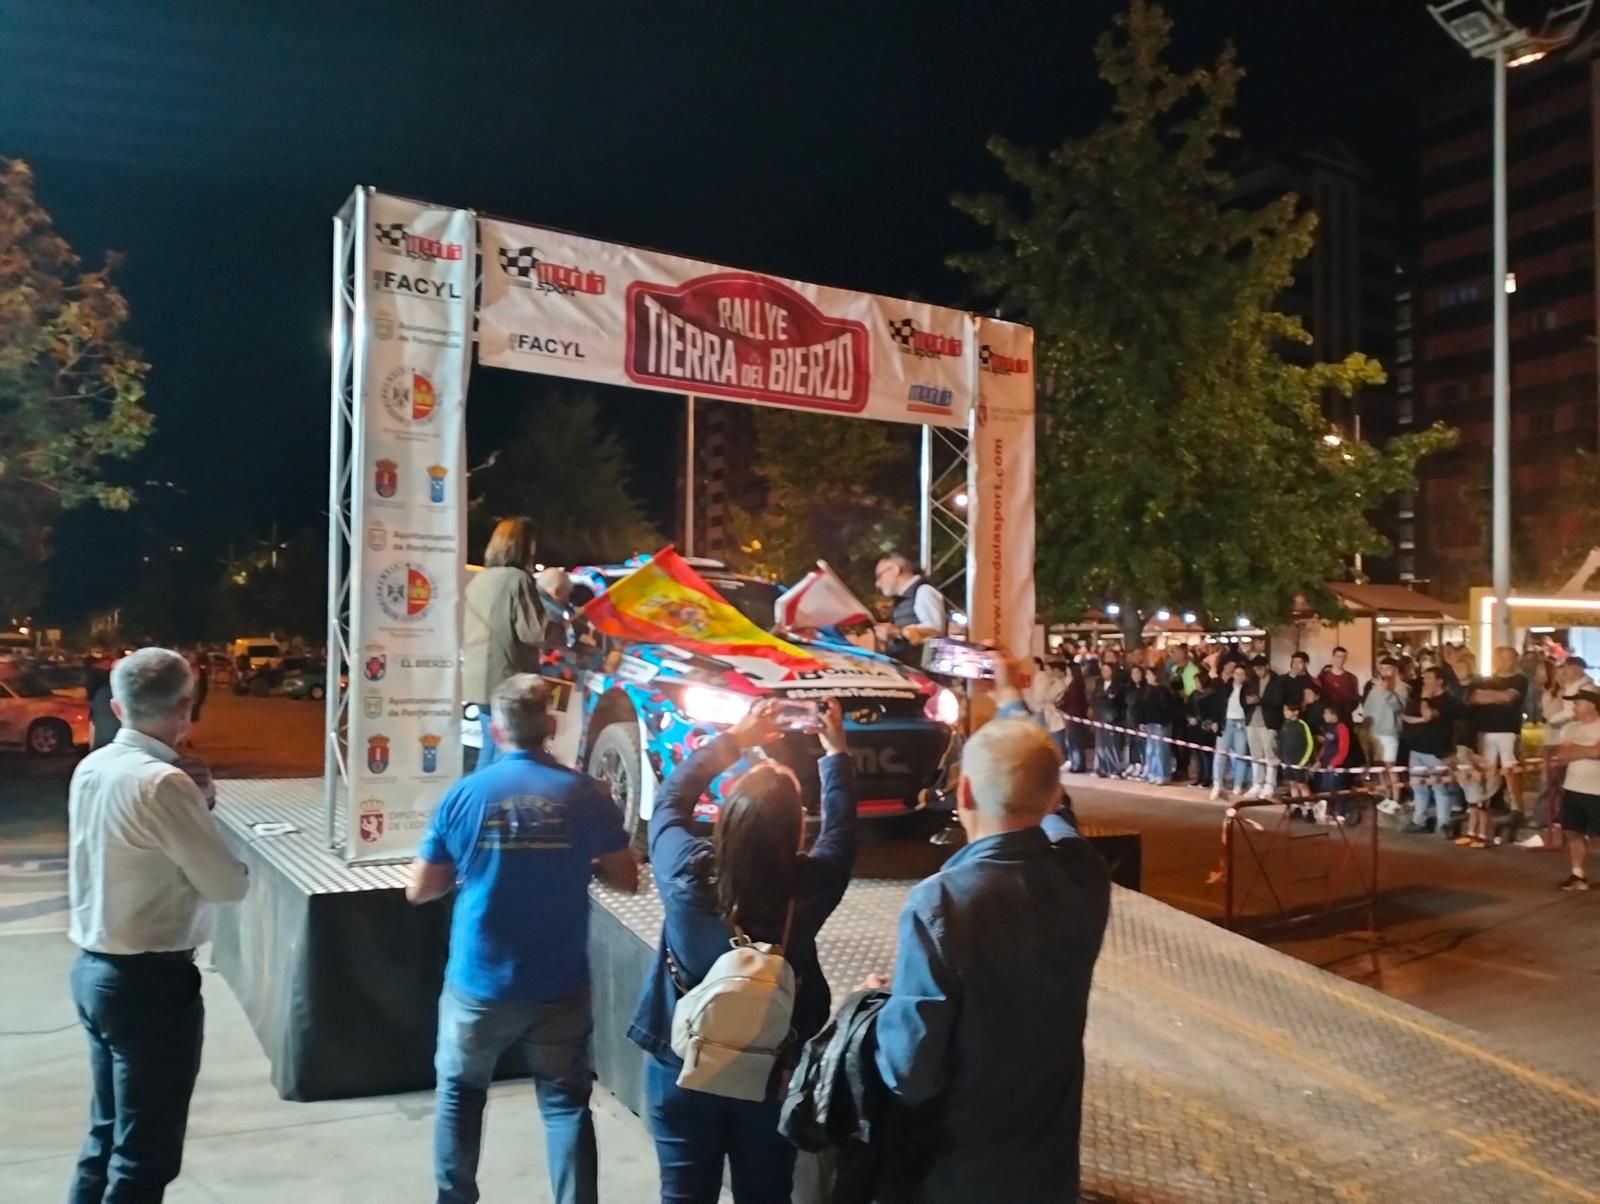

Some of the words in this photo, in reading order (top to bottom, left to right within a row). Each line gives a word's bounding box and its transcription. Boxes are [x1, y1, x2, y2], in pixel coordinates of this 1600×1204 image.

[384, 271, 461, 299] FACYL
[718, 297, 789, 341] RALLYE
[518, 334, 586, 358] FACYL
[644, 294, 738, 385] TIERRA
[741, 363, 765, 389] DEL
[768, 332, 854, 401] BIERZO
[415, 658, 454, 669] BIERZO
